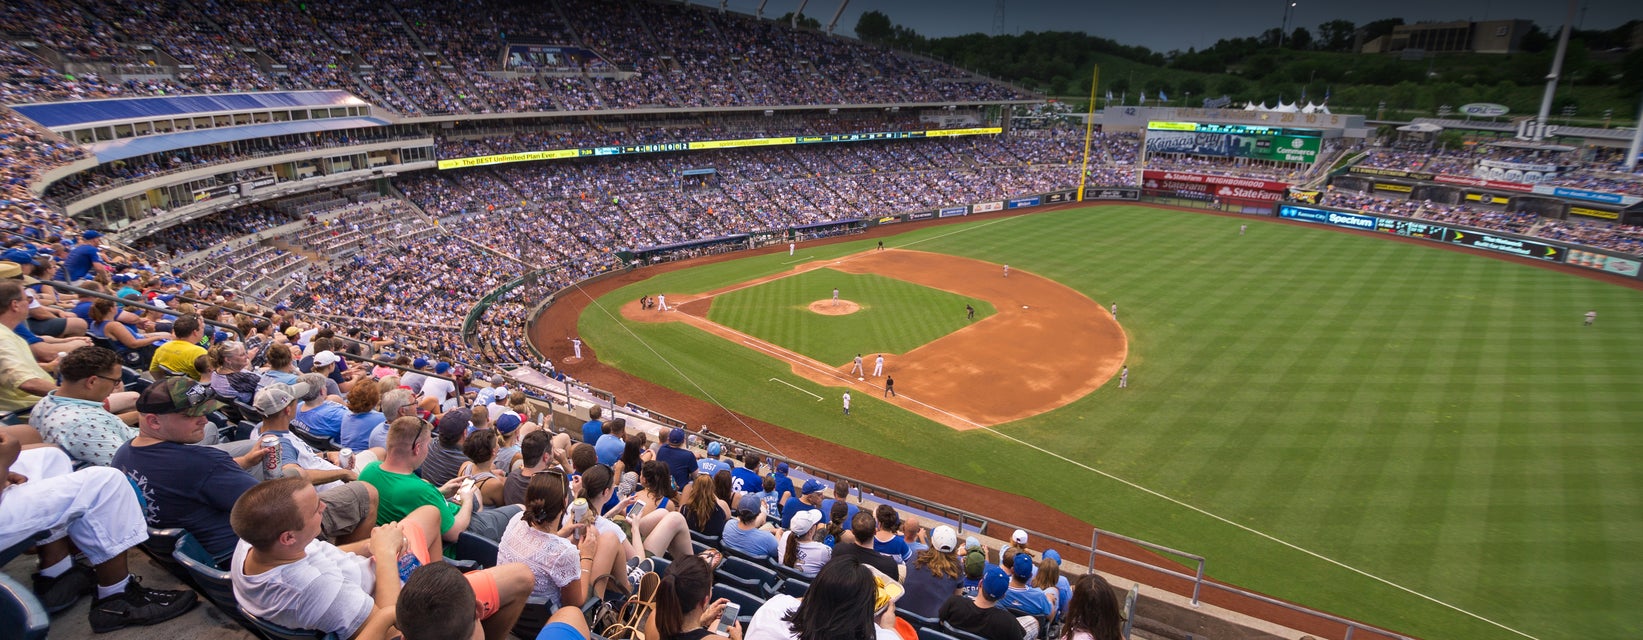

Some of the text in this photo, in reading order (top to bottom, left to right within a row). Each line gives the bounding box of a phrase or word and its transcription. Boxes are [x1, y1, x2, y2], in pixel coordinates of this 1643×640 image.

[1281, 114, 1295, 123] 20
[1306, 115, 1317, 124] 10
[1330, 116, 1338, 124] 5
[1146, 132, 1221, 152] Kansas City
[1276, 146, 1316, 157] Commerce
[463, 159, 476, 167] The
[476, 157, 493, 165] BEST
[494, 154, 527, 164] Unlimited
[527, 152, 541, 161] Plan
[1285, 154, 1304, 162] Bank
[1205, 176, 1266, 188] NEIGHBORHOOD
[1329, 213, 1374, 228] Spectrum
